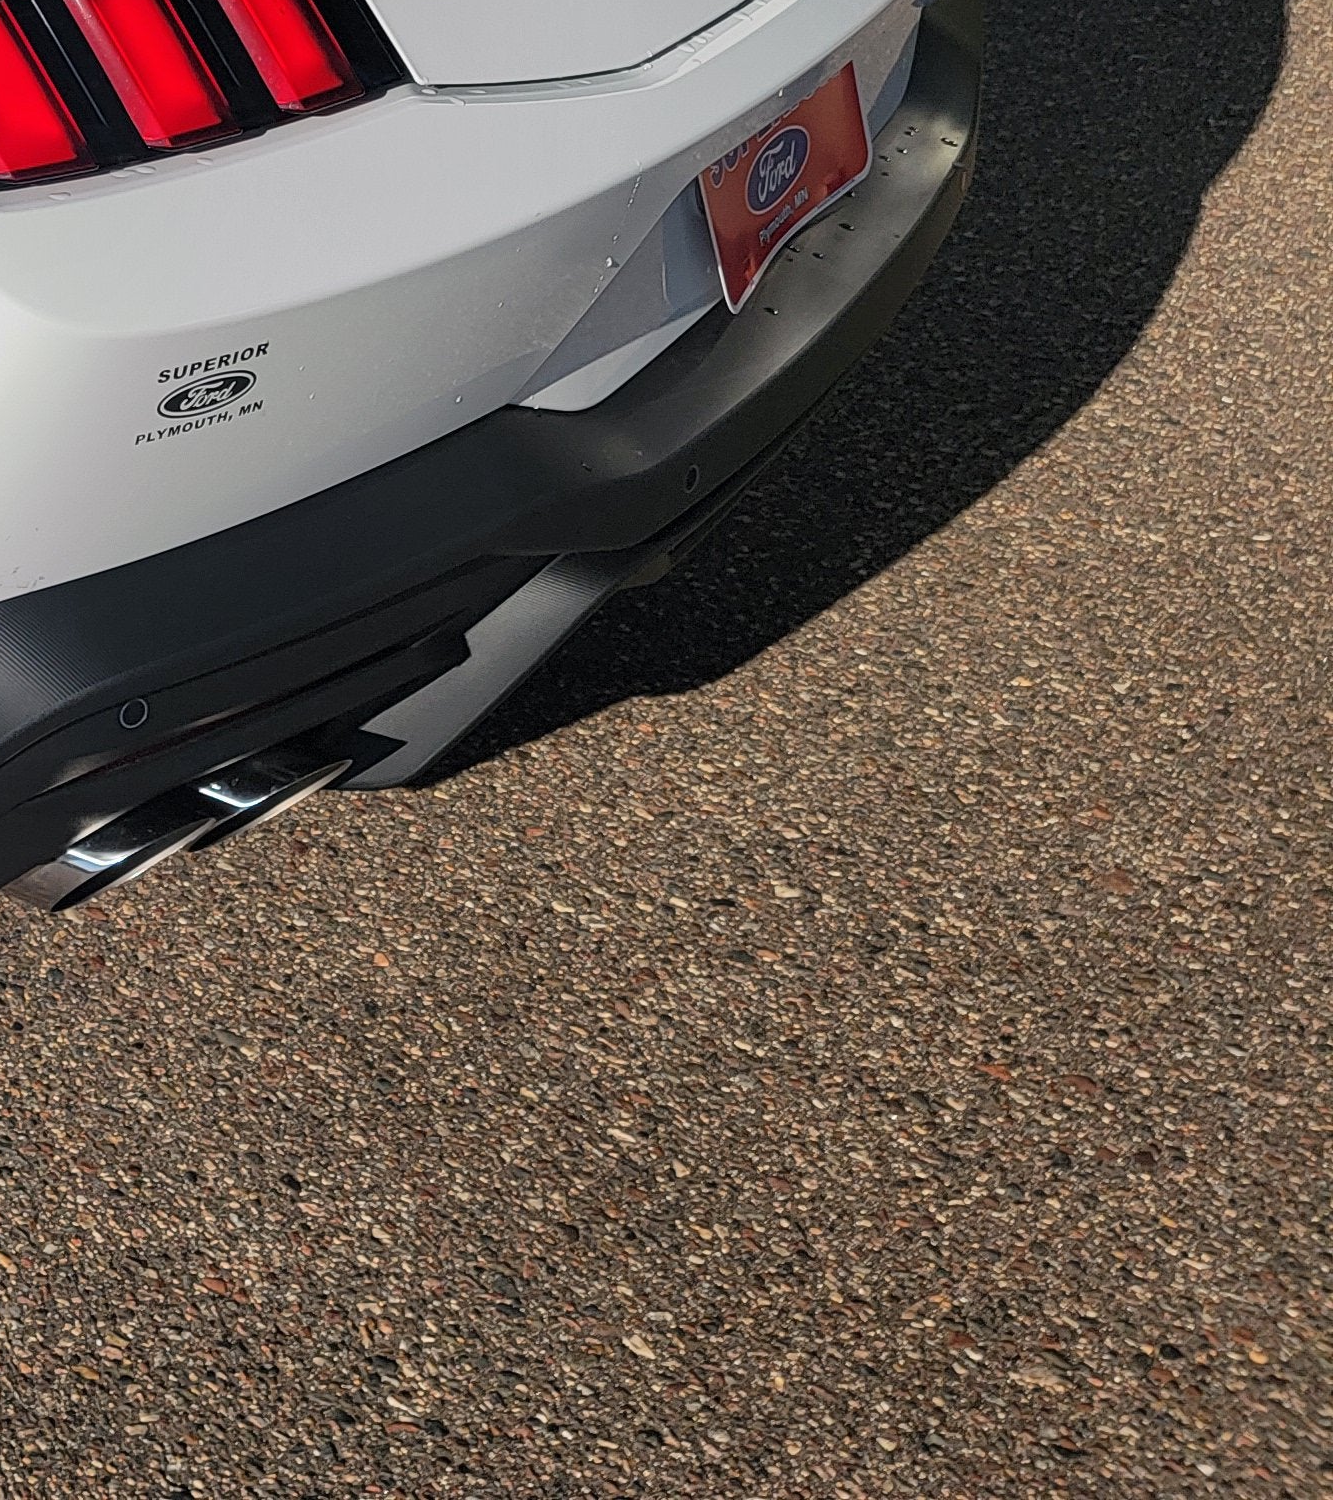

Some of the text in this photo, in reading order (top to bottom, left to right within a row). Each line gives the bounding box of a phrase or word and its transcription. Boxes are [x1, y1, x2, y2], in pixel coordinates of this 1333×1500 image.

[757, 138, 798, 204] Ford
[157, 340, 271, 385] SUPERIOR
[134, 399, 265, 446] PLYMOUTH, MN
